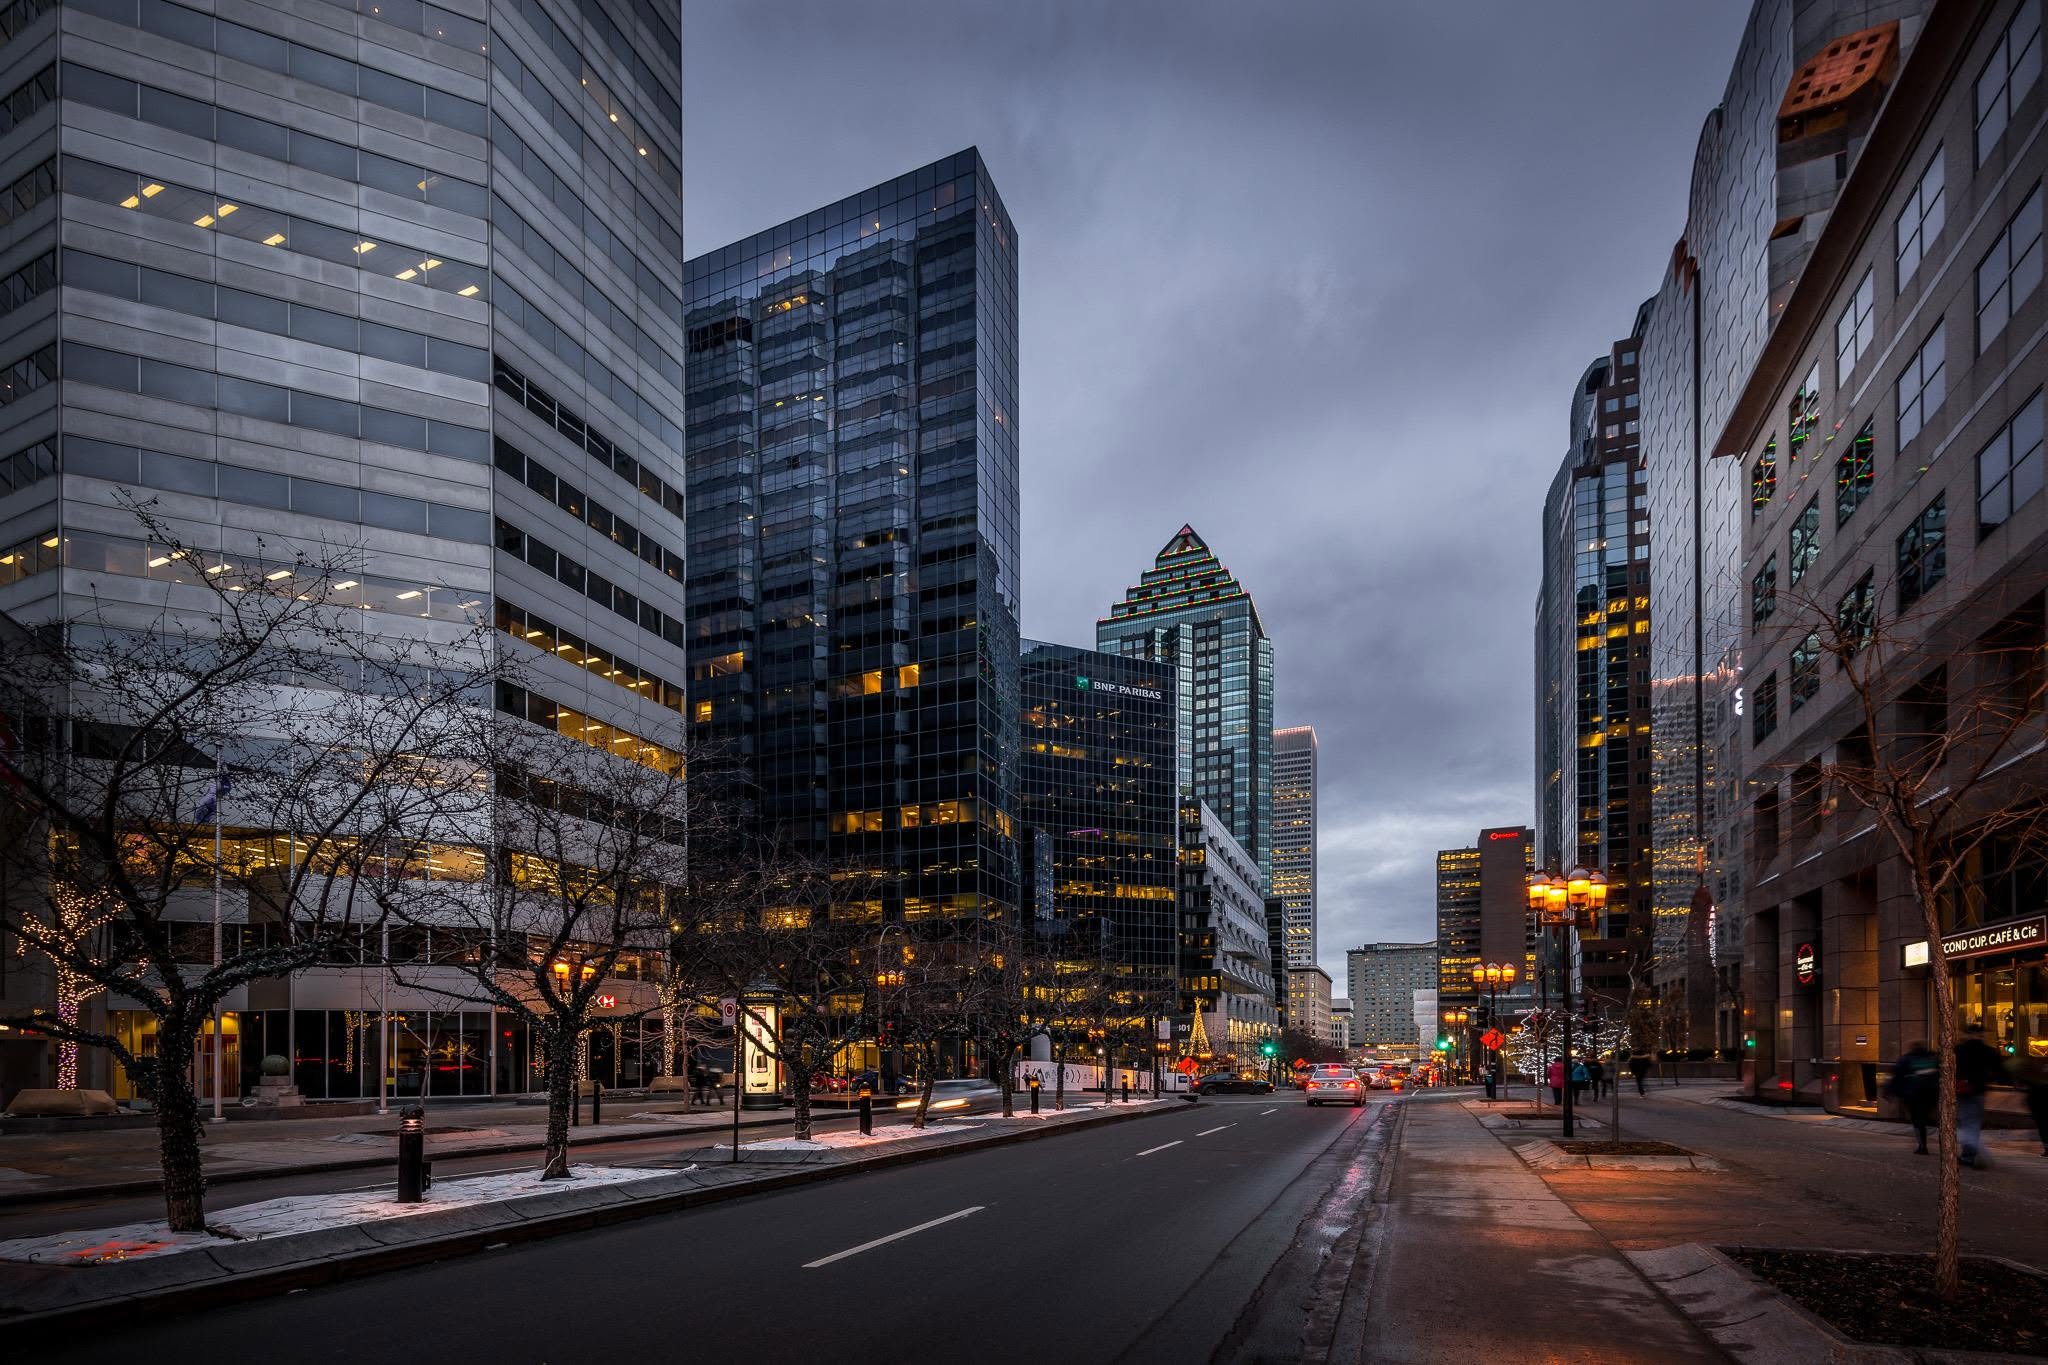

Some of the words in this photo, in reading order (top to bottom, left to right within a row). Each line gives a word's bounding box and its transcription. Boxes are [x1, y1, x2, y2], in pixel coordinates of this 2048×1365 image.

[1094, 681, 1115, 692] BNP
[1119, 686, 1161, 700] PARIBAS
[1942, 940, 1968, 954] COND
[1989, 926, 2012, 945] CAFÉ
[2013, 928, 2020, 941] &
